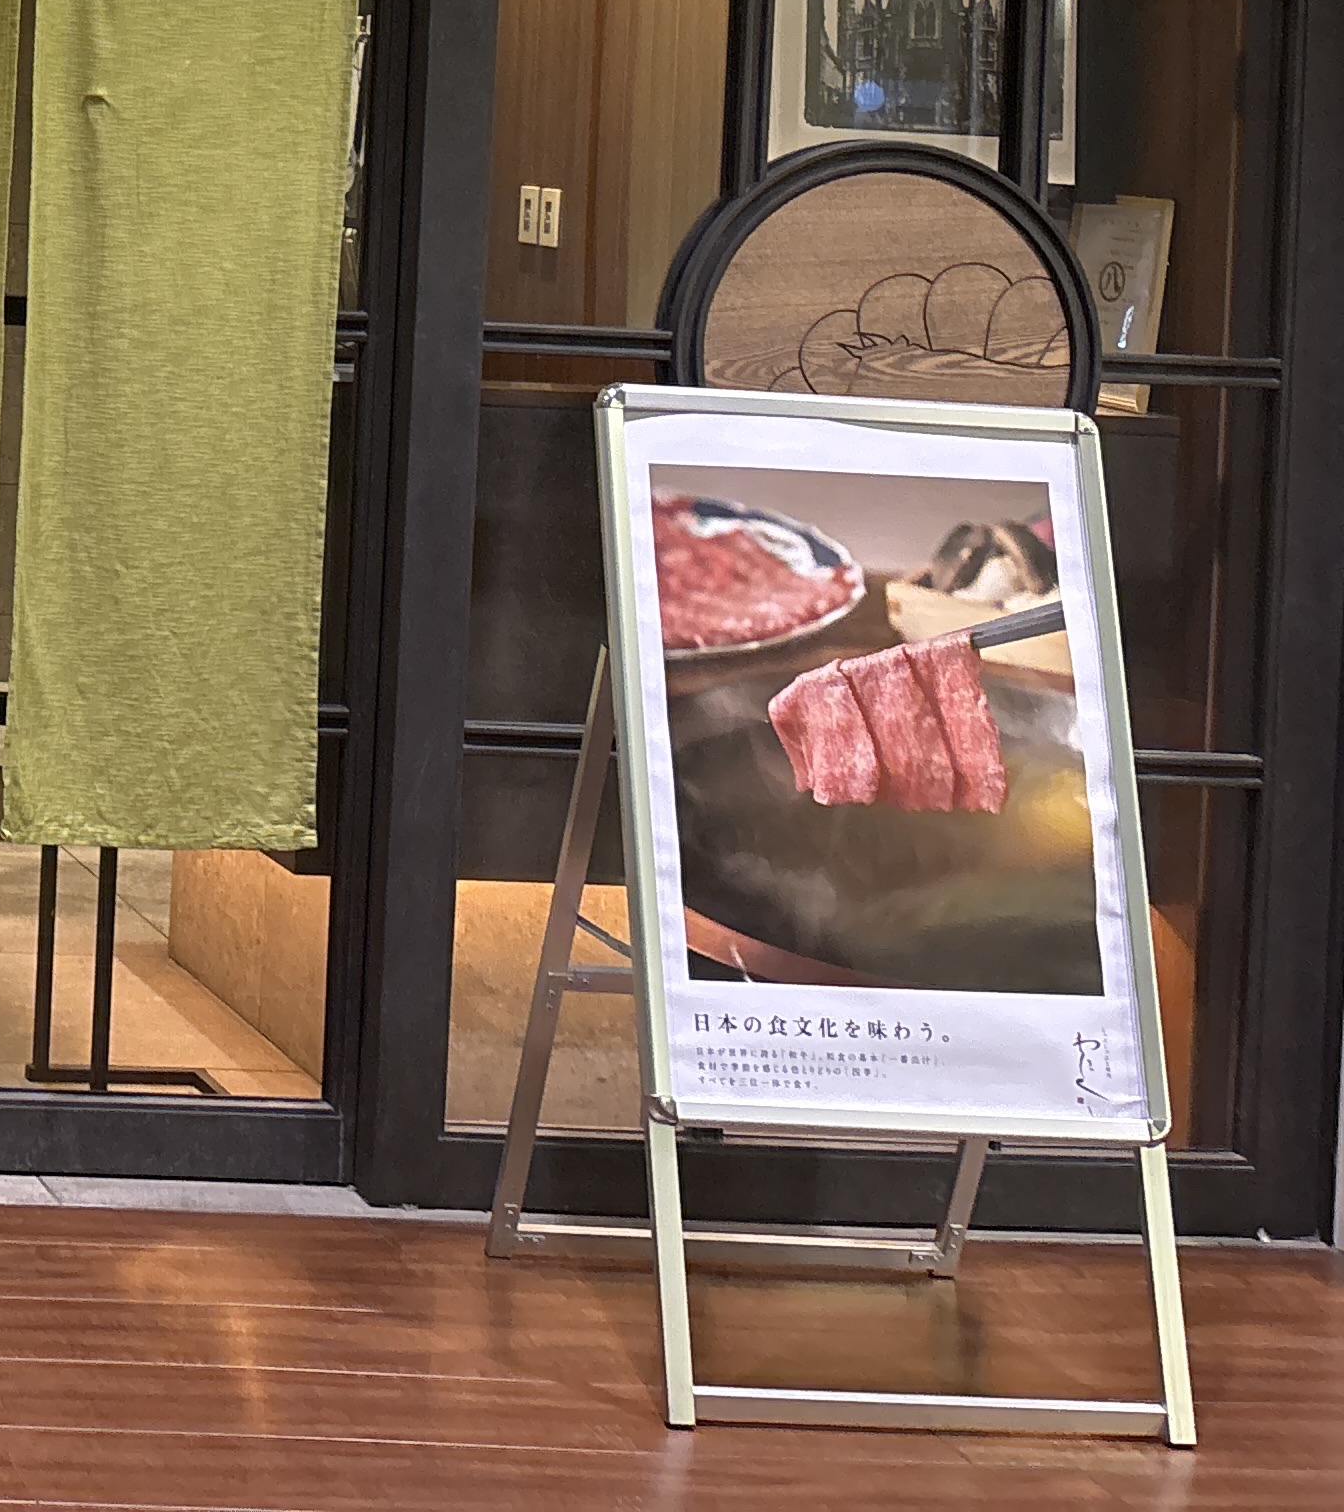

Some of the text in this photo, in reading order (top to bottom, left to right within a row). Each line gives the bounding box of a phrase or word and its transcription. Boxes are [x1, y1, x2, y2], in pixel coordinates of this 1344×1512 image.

[694, 1013, 950, 1043] 日本の食文化を味わう。
